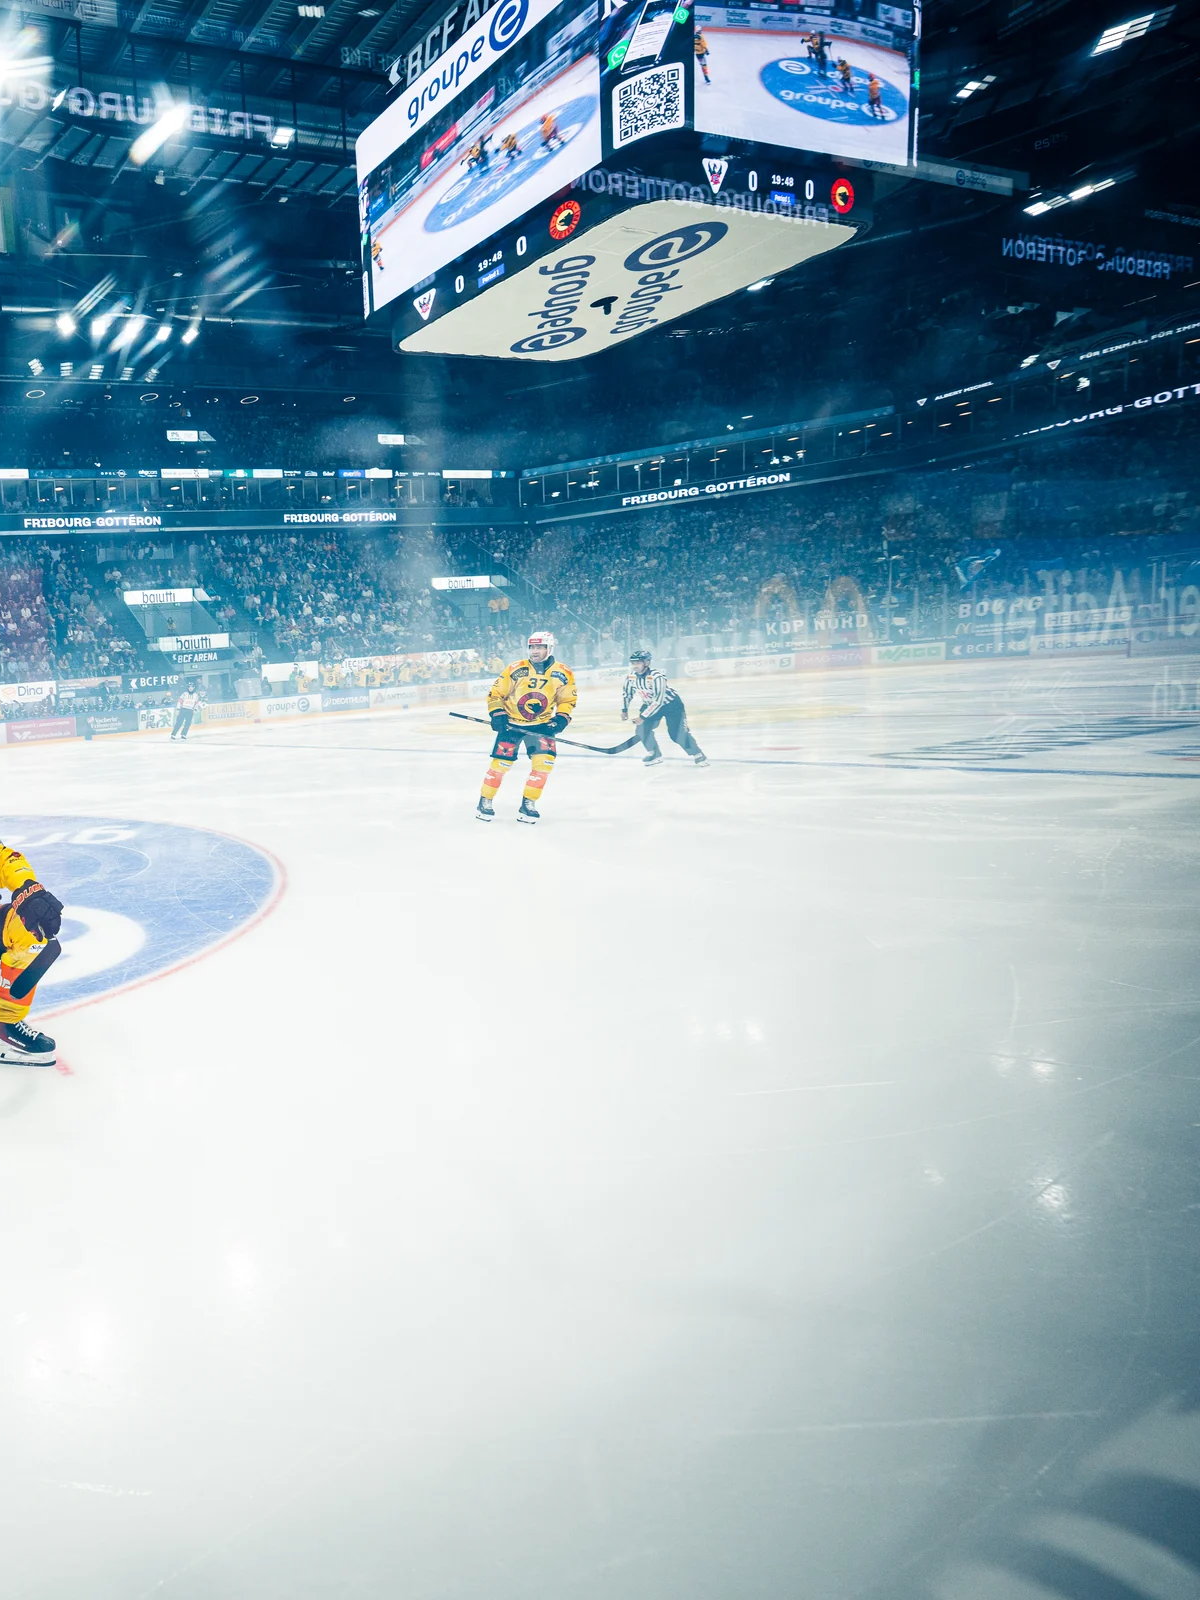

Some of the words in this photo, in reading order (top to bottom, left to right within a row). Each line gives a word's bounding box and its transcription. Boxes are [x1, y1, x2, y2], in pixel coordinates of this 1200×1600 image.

[406, 6, 458, 87] BCF
[407, 35, 485, 128] groupe
[780, 90, 859, 111] groupe
[749, 171, 758, 191] 0
[771, 174, 794, 187] 19:48
[805, 180, 814, 200] 0
[455, 275, 464, 293] 0
[478, 250, 503, 272] 19:48
[516, 235, 527, 256] 0
[528, 254, 596, 330] groupe
[610, 268, 684, 334] groupe
[934, 388, 962, 402] ALBERT
[963, 380, 994, 394] MICHEL
[621, 472, 791, 507] FRIBOURG-GOTTÉRON
[23, 513, 162, 529] FRIBOURG-GOTTÉRON
[283, 510, 397, 523] FRIBOURG-GOTTÉRON
[448, 578, 474, 589] baiutti
[142, 589, 176, 603] baiutti
[176, 634, 212, 650] baiutti
[967, 643, 993, 653] BCF
[177, 654, 193, 663] BCF
[194, 651, 218, 662] ARENA
[140, 677, 158, 687] BCF
[161, 675, 179, 685] FKB
[528, 677, 548, 690] 37
[17, 686, 43, 697] Dina
[266, 701, 297, 714] groupe
[331, 695, 369, 705] DECATHLON
[141, 713, 155, 723] Big
